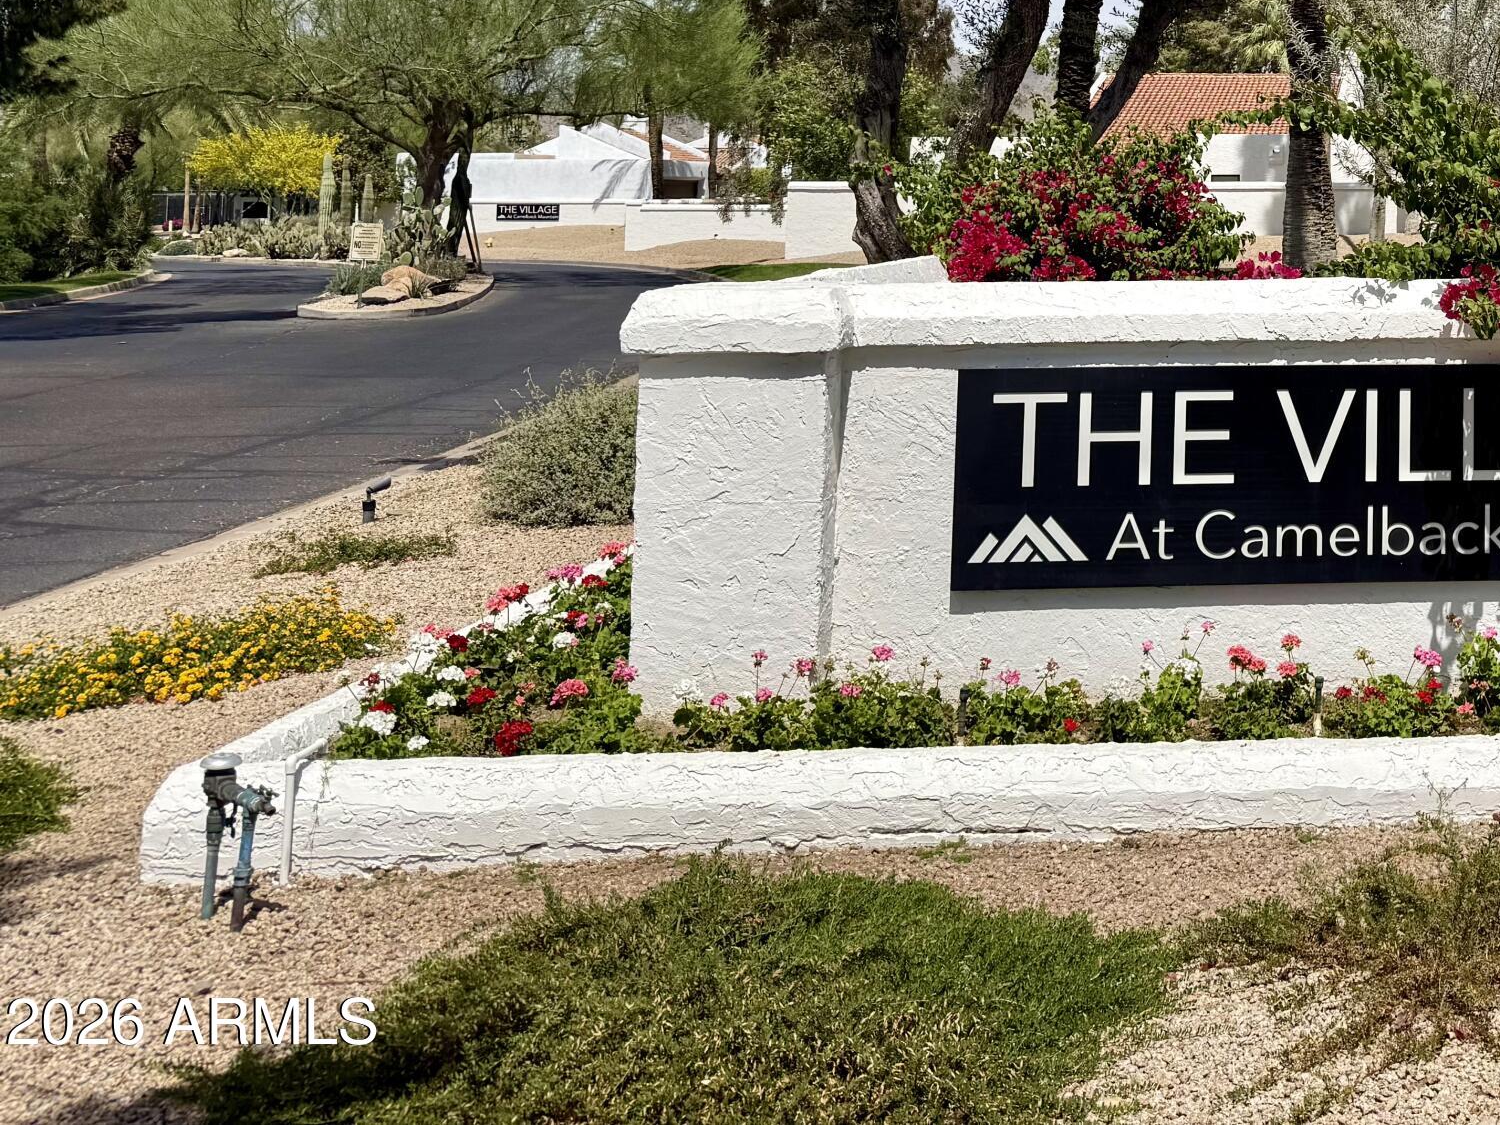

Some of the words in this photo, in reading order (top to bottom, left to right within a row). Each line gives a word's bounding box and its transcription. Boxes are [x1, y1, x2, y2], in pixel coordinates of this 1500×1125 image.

[498, 206, 517, 214] THE
[519, 206, 558, 214] VILLAGE
[354, 241, 361, 249] NO
[992, 390, 1235, 488] THE
[1105, 512, 1175, 561] At
